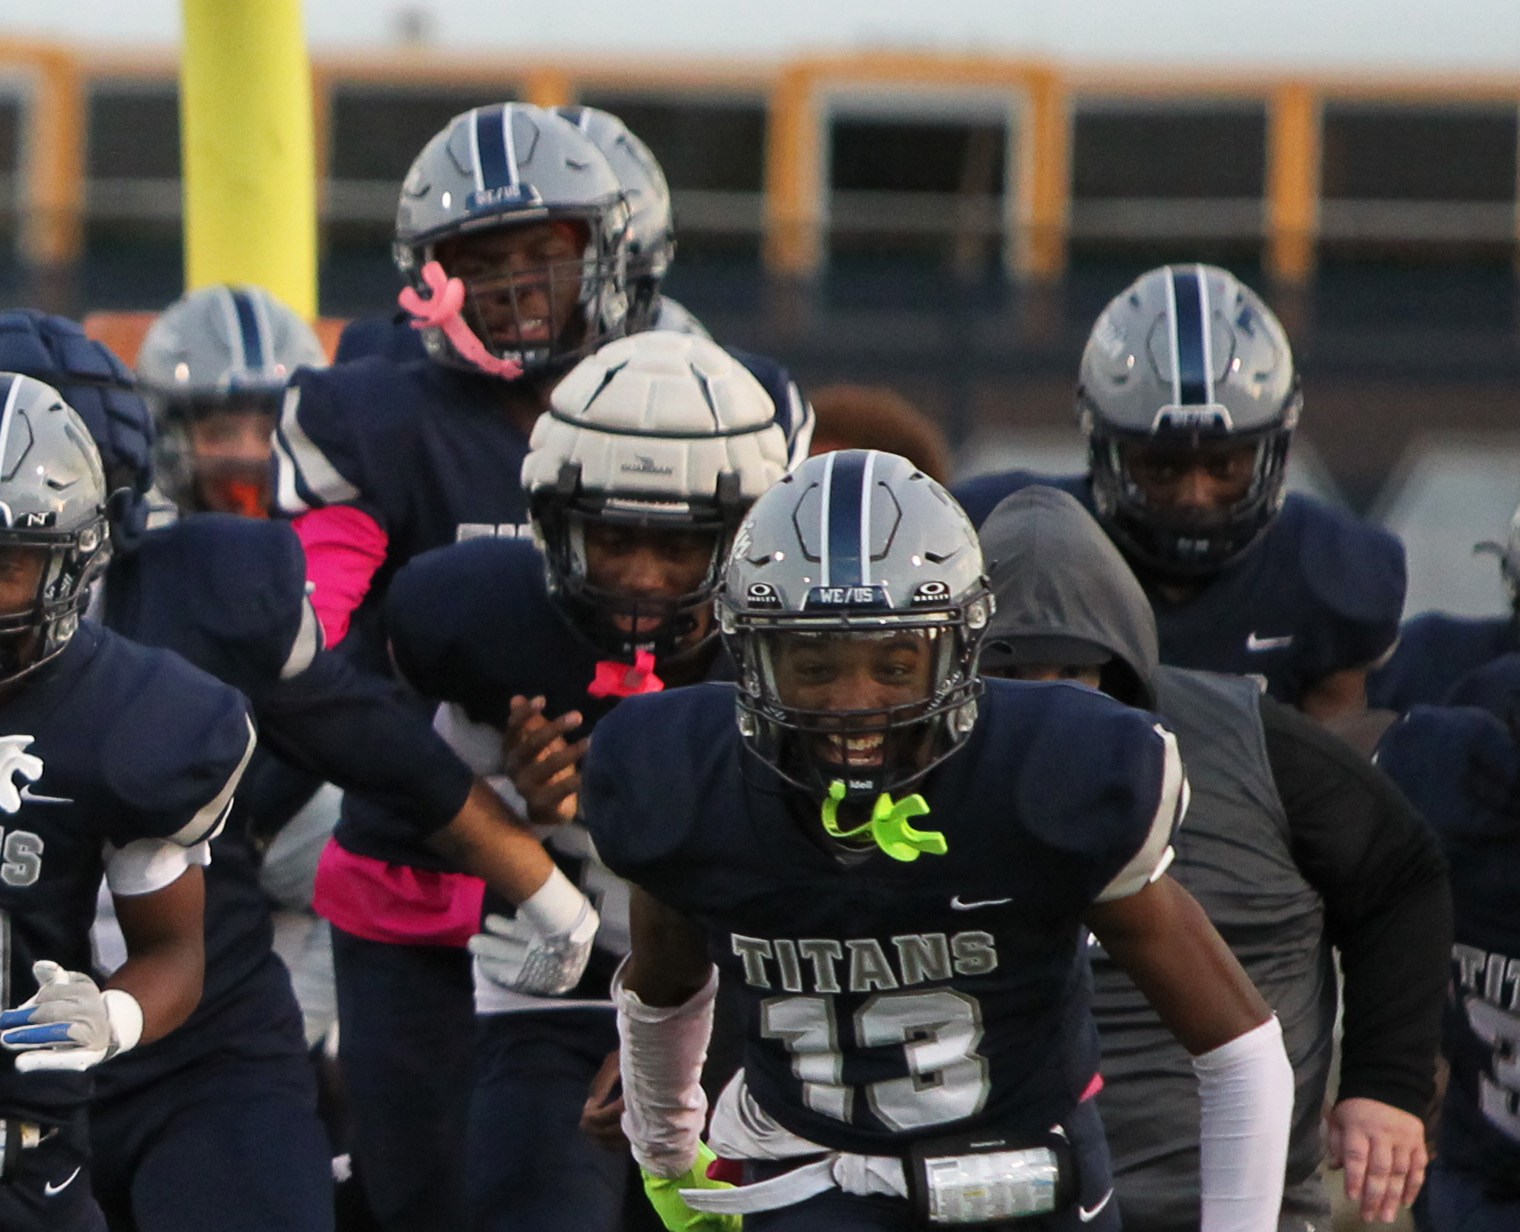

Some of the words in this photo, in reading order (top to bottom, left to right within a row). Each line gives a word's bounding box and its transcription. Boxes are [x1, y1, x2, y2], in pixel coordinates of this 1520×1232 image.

[820, 587, 874, 604] WE/US
[731, 929, 998, 993] TITANS
[761, 987, 992, 1132] 13
